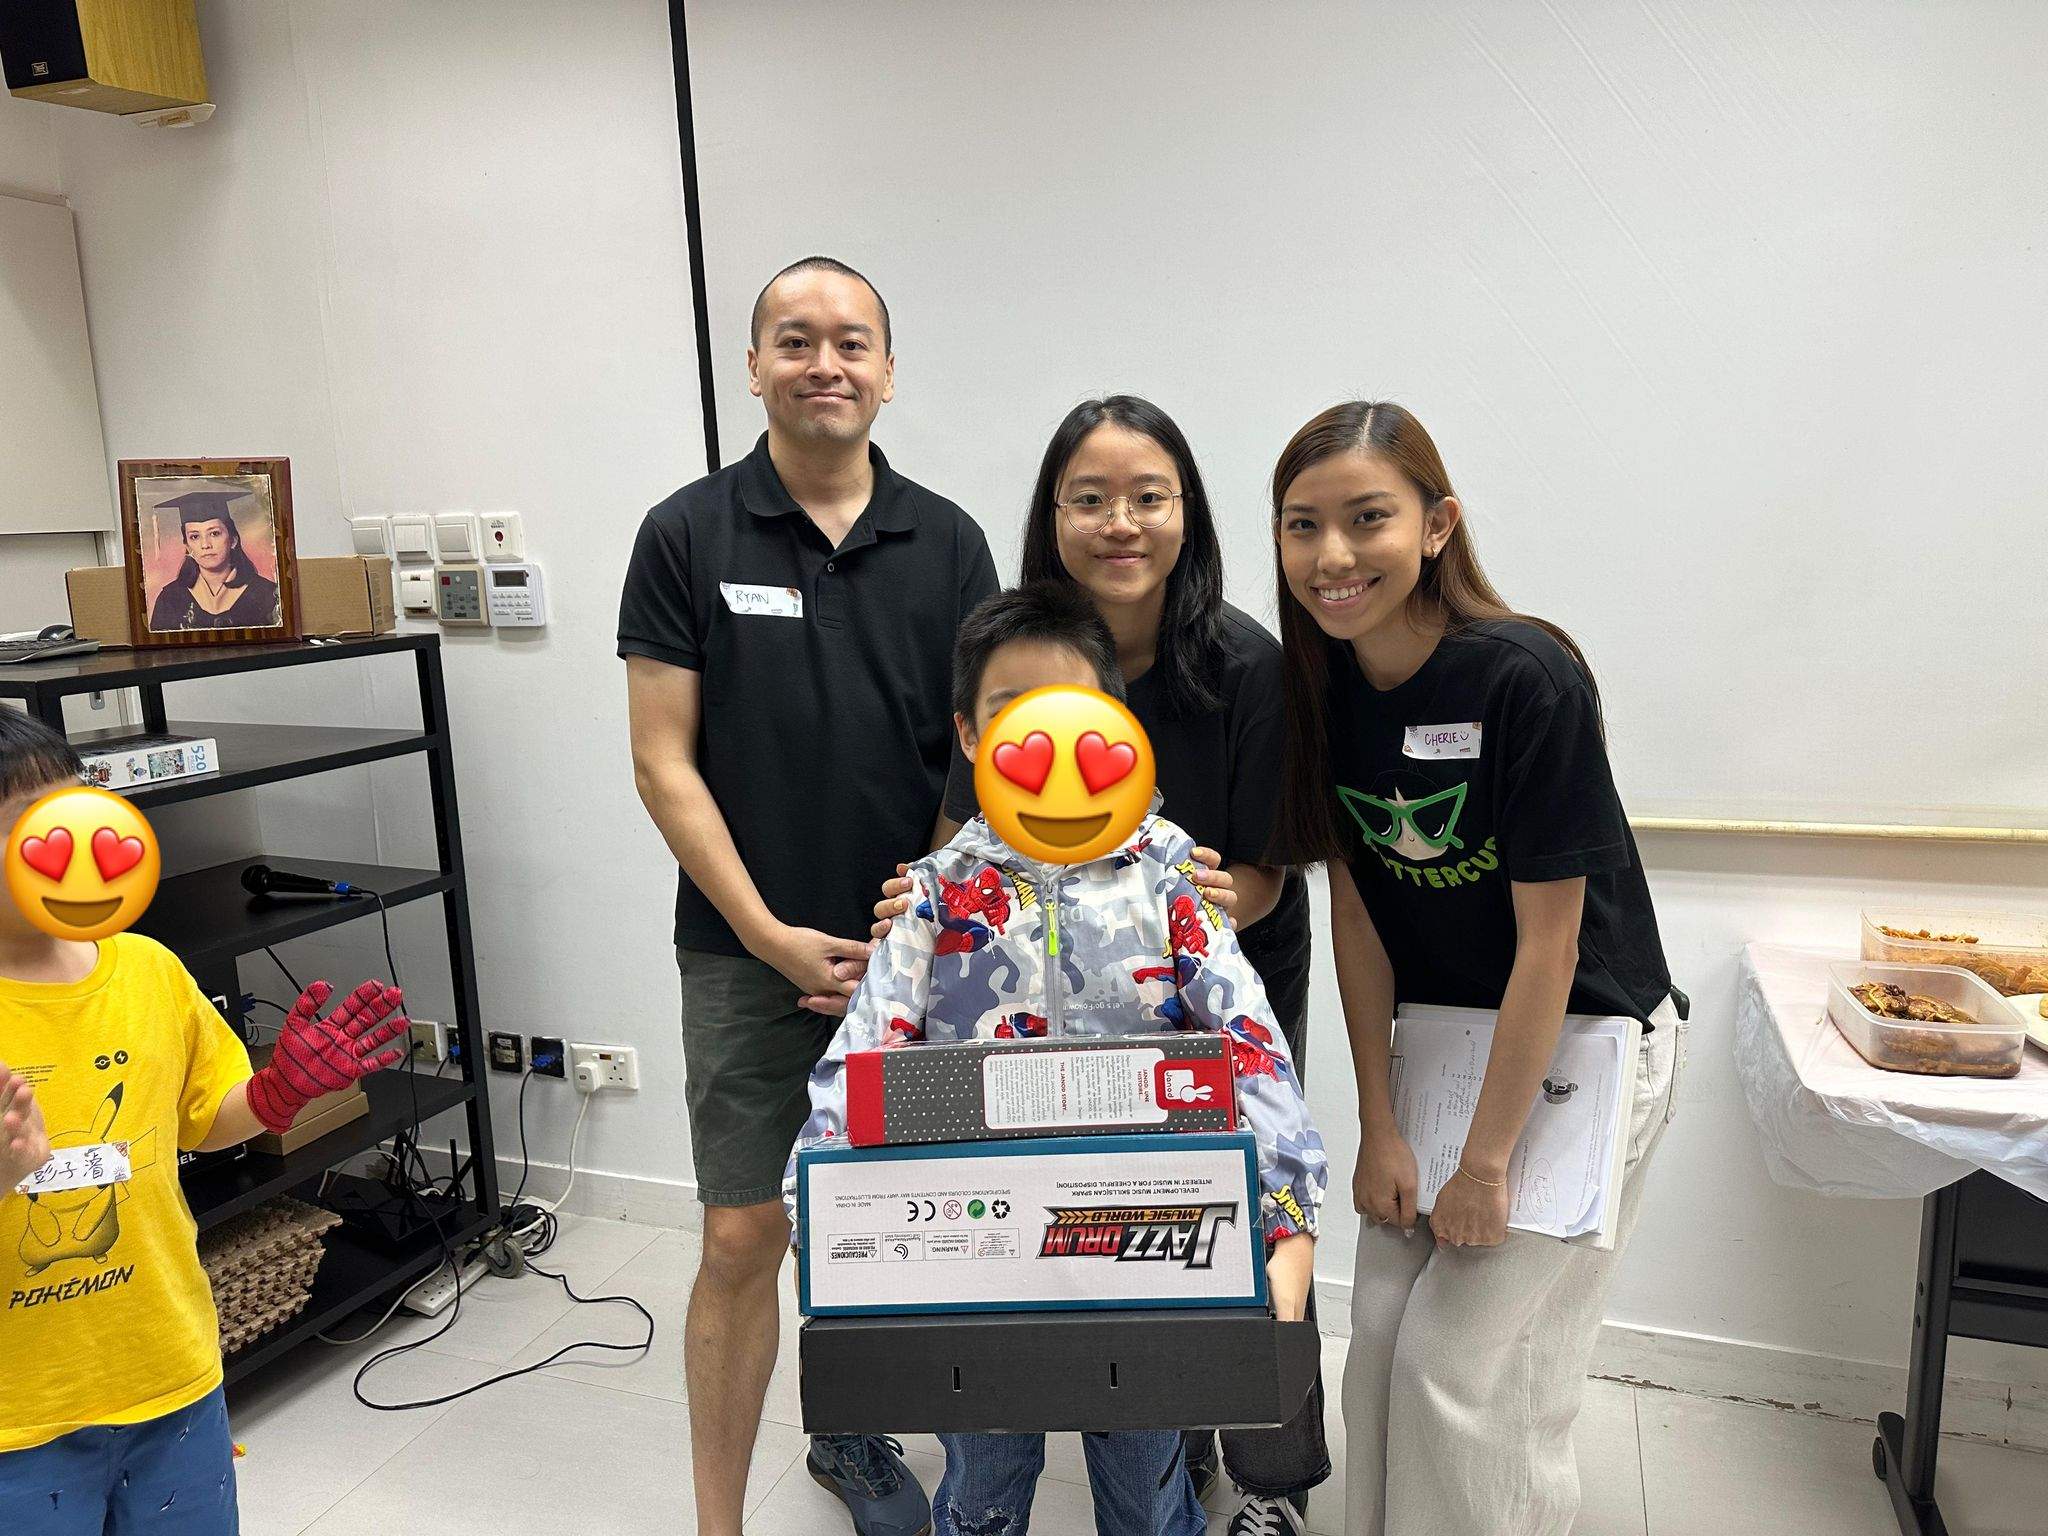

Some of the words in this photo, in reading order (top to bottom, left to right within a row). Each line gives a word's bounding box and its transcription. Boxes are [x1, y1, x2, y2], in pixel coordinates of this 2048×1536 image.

[735, 590, 769, 604] RYAN
[1425, 732, 1458, 746] CHERIE
[191, 745, 207, 771] 520
[1166, 1072, 1174, 1098] Janod
[1091, 1210, 1146, 1222] WORLD
[1149, 1209, 1196, 1221] MUSIC
[1043, 1225, 1124, 1256] DRUM
[1123, 1206, 1236, 1269] JAZZ
